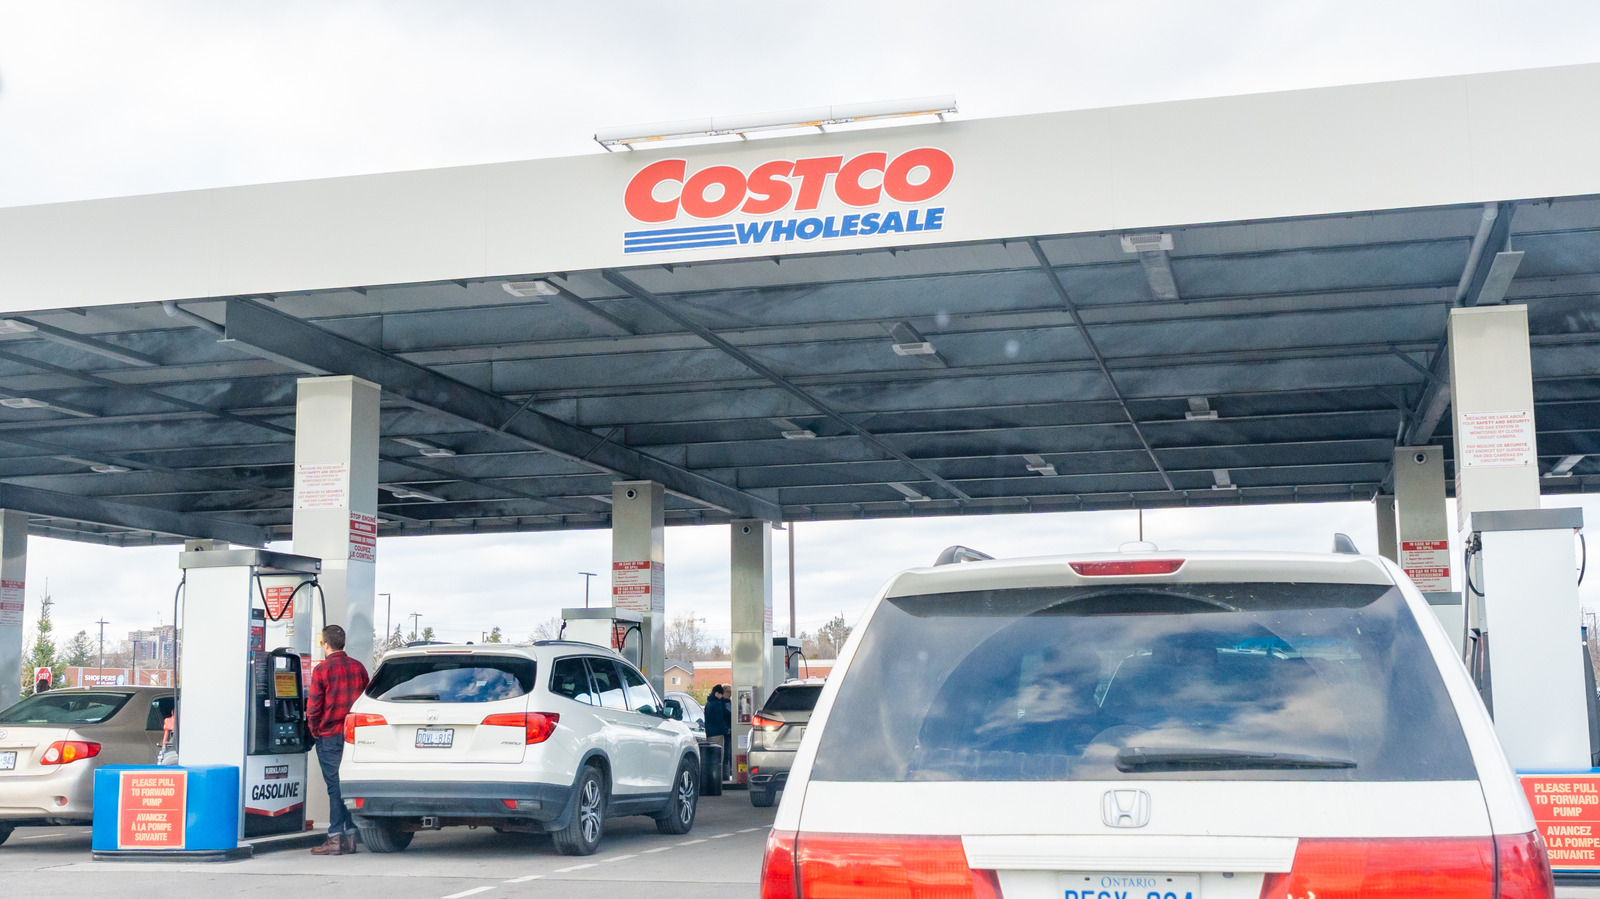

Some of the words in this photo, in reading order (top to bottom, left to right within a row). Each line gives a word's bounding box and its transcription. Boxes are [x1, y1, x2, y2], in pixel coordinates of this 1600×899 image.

[624, 148, 955, 223] COSTCO
[736, 208, 946, 245] WHOLESALE
[355, 545, 370, 553] COUPEZ
[356, 552, 374, 560] CONTACT
[132, 779, 157, 787] PLEASE
[158, 778, 175, 786] PULL
[132, 788, 140, 796] TO
[141, 788, 175, 796] FORWARD
[252, 782, 299, 800] GASOLINE
[1534, 783, 1571, 793] PLEASE
[1574, 783, 1598, 793] PULL
[142, 798, 162, 806] PUMP
[1535, 795, 1548, 805] TO
[1550, 795, 1599, 805] FORWARD
[1553, 807, 1582, 817] PUMP
[136, 814, 167, 822] AVANCEZ
[131, 822, 136, 831] À
[138, 823, 146, 831] LA
[148, 823, 172, 831] POMPE
[1547, 826, 1592, 836] AVANCEZ
[135, 833, 167, 841] SUIVANTE
[1550, 838, 1563, 847] LA
[1565, 838, 1600, 847] POMPE
[1548, 850, 1595, 859] SUIVANTE
[1101, 876, 1156, 888] ONTARIO
